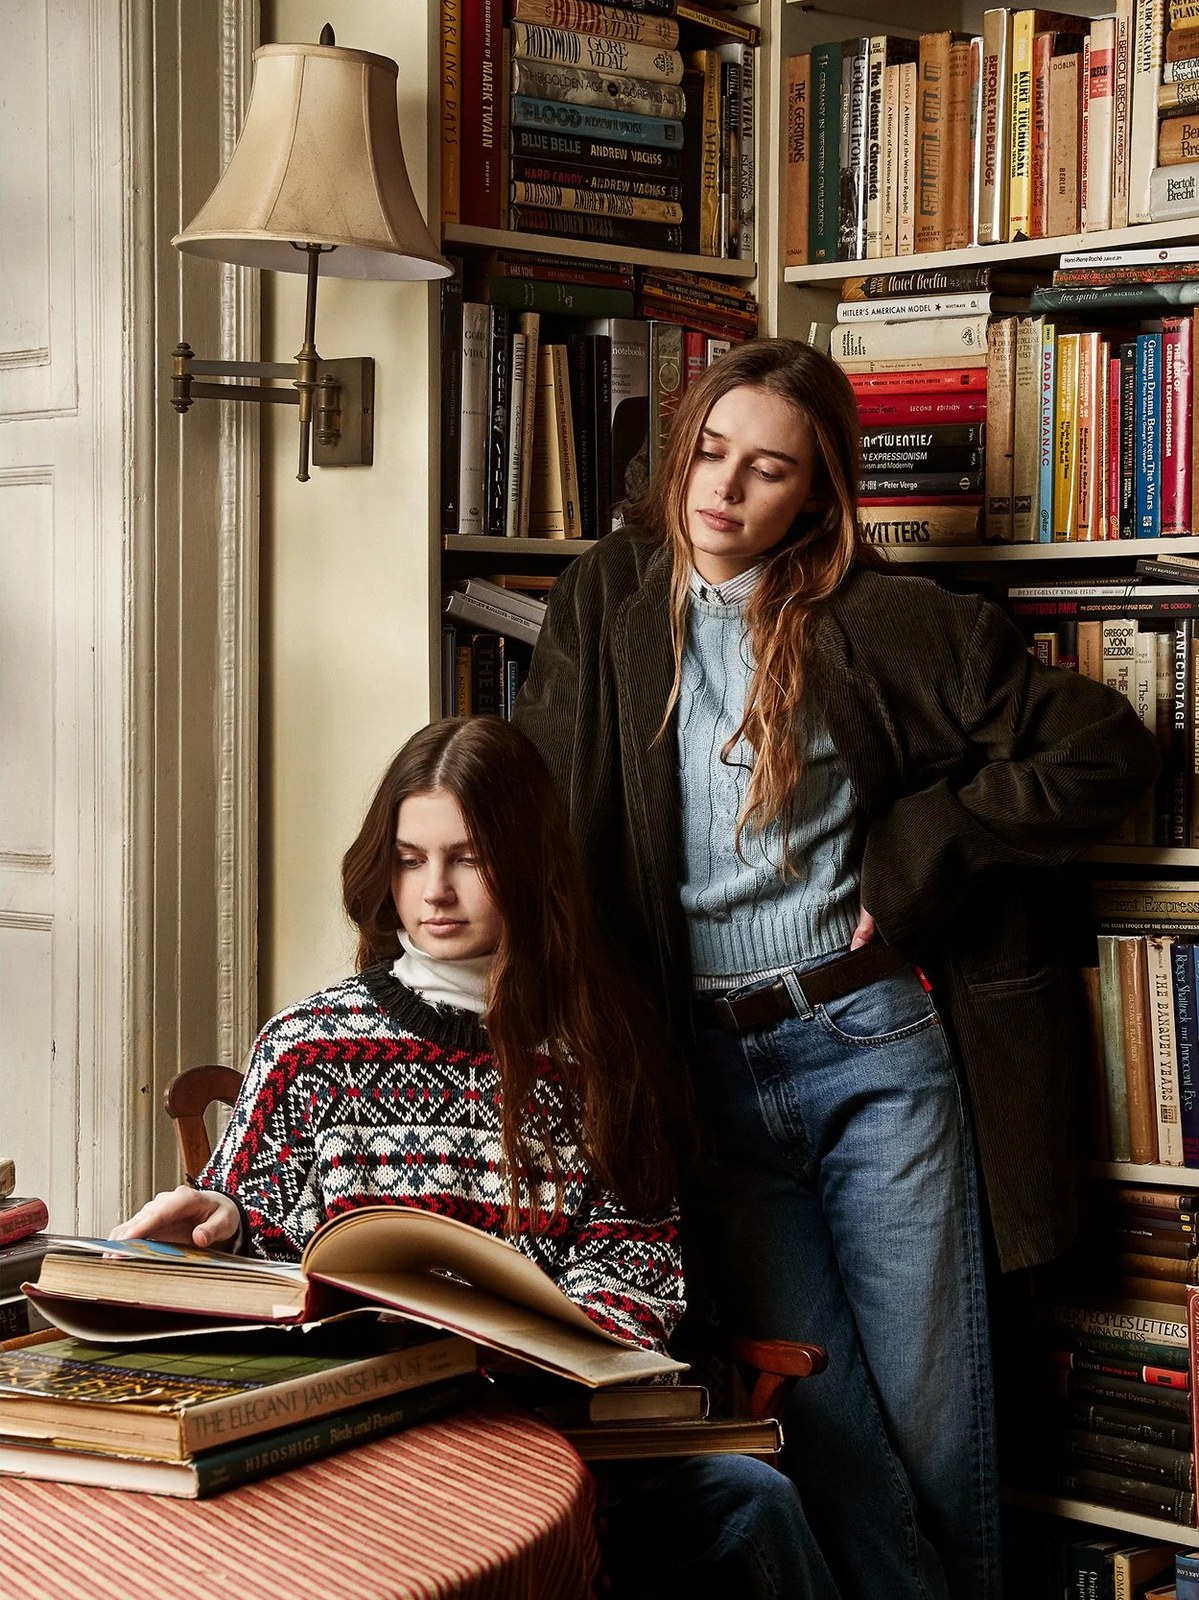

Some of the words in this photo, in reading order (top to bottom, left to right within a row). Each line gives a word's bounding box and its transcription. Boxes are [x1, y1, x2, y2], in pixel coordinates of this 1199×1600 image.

[602, 8, 644, 26] GORE
[1174, 6, 1199, 20] PLAYS
[443, 0, 457, 90] DARLING
[525, 25, 581, 64] HOLLYWOOD
[604, 20, 644, 42] VIDAL
[1143, 8, 1152, 73] BIOGRAPHY
[484, 49, 491, 58] OF
[587, 50, 628, 72] VIDAL
[588, 36, 628, 57] GORE
[1118, 39, 1126, 80] BERTOLT
[742, 50, 753, 92] GORE
[852, 56, 864, 93] Gold
[870, 61, 882, 87] The
[982, 56, 990, 73] Otto
[986, 54, 998, 100] BEFORE
[1053, 60, 1076, 71] DOBLIN
[1173, 68, 1199, 82] Brecht
[482, 61, 493, 101] MARK
[544, 72, 583, 89] GOLDEN
[585, 80, 603, 93] AGE
[622, 87, 649, 101] GORE
[650, 92, 674, 105] VIDAL
[729, 67, 739, 95] GORE
[794, 80, 806, 104] THE
[818, 71, 827, 116] GERMANY
[1018, 71, 1030, 103] KURT
[852, 97, 862, 125] and
[1035, 76, 1044, 118] WHAT
[1117, 84, 1126, 122] BRECHT
[444, 100, 458, 145] DAYS
[482, 105, 493, 148] TWAIN
[519, 101, 582, 127] FLOOD
[742, 96, 753, 142] VIDAL
[818, 119, 826, 129] IN
[869, 89, 881, 141] Weimar
[986, 101, 996, 131] THE
[521, 132, 549, 150] BLUE
[551, 137, 581, 154] BELLE
[590, 144, 628, 161] ANDREW
[631, 150, 662, 165] VACHSS
[793, 107, 806, 163] GERMANS
[850, 129, 861, 167] Iron
[1017, 108, 1029, 178] TUCHOLSKY
[704, 118, 716, 194] EMPIRE
[818, 131, 827, 173] WESTERN
[985, 134, 996, 187] DELUGE
[523, 167, 550, 180] HARD
[552, 171, 583, 185] CANDY
[591, 176, 630, 192] ANDREW
[633, 181, 667, 197] VACHSS
[869, 142, 880, 201] Chronicle
[1058, 168, 1066, 195] BERLIN
[1166, 176, 1196, 190] Bertolt
[525, 183, 563, 207] BLOSSOM
[574, 189, 606, 213] ANDREW
[607, 194, 635, 217] VACHSS
[817, 176, 825, 236] CIVILIZATION
[1166, 188, 1195, 202] Brecht
[888, 274, 914, 292] Hotel
[917, 273, 948, 291] Berlin
[1060, 292, 1074, 304] free
[1075, 291, 1099, 302] spirits
[842, 307, 869, 317] HITLER'S
[871, 304, 906, 315] AMERICAN
[907, 304, 931, 314] MODEL
[1147, 339, 1157, 380] German
[1173, 342, 1181, 359] THE
[496, 351, 507, 403] GORE
[1043, 351, 1051, 392] DADA
[1173, 379, 1180, 392] OF
[909, 404, 932, 412] SECOND
[936, 404, 960, 412] EDITION
[1147, 382, 1156, 416] Drama
[1041, 397, 1050, 467] ALMANAC
[1165, 384, 1173, 457] EXPRESSIONISM
[561, 425, 571, 482] GRANDMOTHERS
[880, 434, 933, 448] TWENTIES
[1146, 418, 1156, 460] Between
[512, 452, 521, 472] JOHN
[868, 452, 928, 461] EXPRESSIONISM
[887, 462, 914, 470] Modernity
[1146, 462, 1155, 480] The
[493, 442, 505, 510] VIDAL
[511, 473, 520, 503] WATERS
[883, 480, 900, 490] Peter
[899, 480, 919, 491] Vergo
[1169, 602, 1192, 610] GORDON
[1103, 628, 1134, 638] GREGOR
[1109, 638, 1127, 647] VON
[1103, 647, 1134, 656] REZZORI
[1118, 666, 1128, 691] THE
[1139, 680, 1149, 703] The
[1174, 629, 1186, 730] ANECDOTAGE
[1173, 778, 1184, 840] REZZORI
[1142, 895, 1199, 919] Express
[1174, 954, 1188, 980] Roger
[1155, 973, 1167, 998] THE
[1156, 1001, 1170, 1058] BANQUET
[1160, 1060, 1173, 1102] YEARS
[1180, 1043, 1193, 1090] Innocent
[1183, 1089, 1193, 1112] Eye
[1112, 1328, 1146, 1342] CURTISS
[1136, 1317, 1188, 1340] LETTERS
[191, 1410, 226, 1439] THE
[229, 1389, 301, 1429] ELEGANT
[302, 1369, 370, 1411] JAPANESE
[373, 1355, 422, 1386] HOUSE
[245, 1434, 321, 1472] HIROSHIGE
[330, 1423, 353, 1445] Birds
